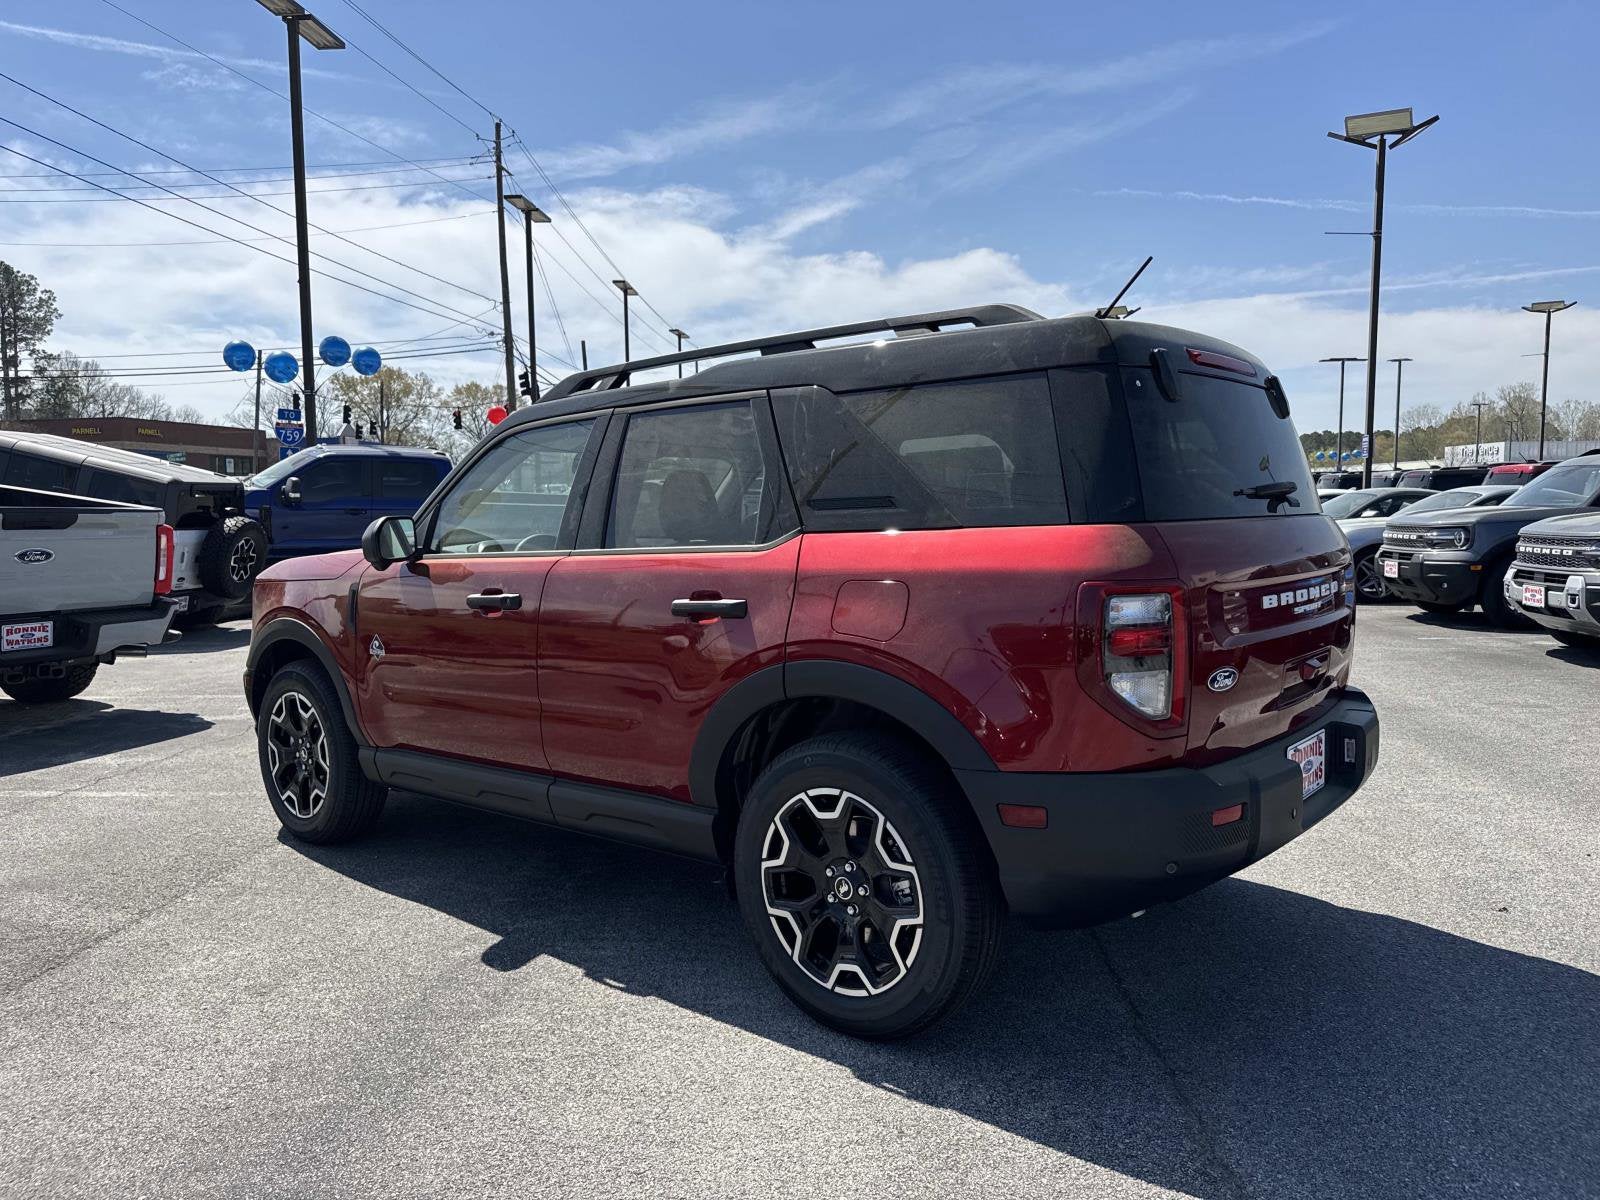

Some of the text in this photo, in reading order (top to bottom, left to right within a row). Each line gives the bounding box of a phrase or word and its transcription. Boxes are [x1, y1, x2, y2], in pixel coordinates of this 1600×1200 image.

[283, 411, 295, 419] TO
[72, 427, 102, 435] PARNELL
[279, 430, 300, 441] 759
[1478, 445, 1500, 456] enue
[24, 551, 46, 561] Ford
[1262, 581, 1339, 609] BRONCO
[5, 625, 49, 637] RONNIE
[5, 635, 49, 647] WATKINS
[1214, 672, 1234, 688] Ford
[1303, 761, 1323, 790] TKINS
